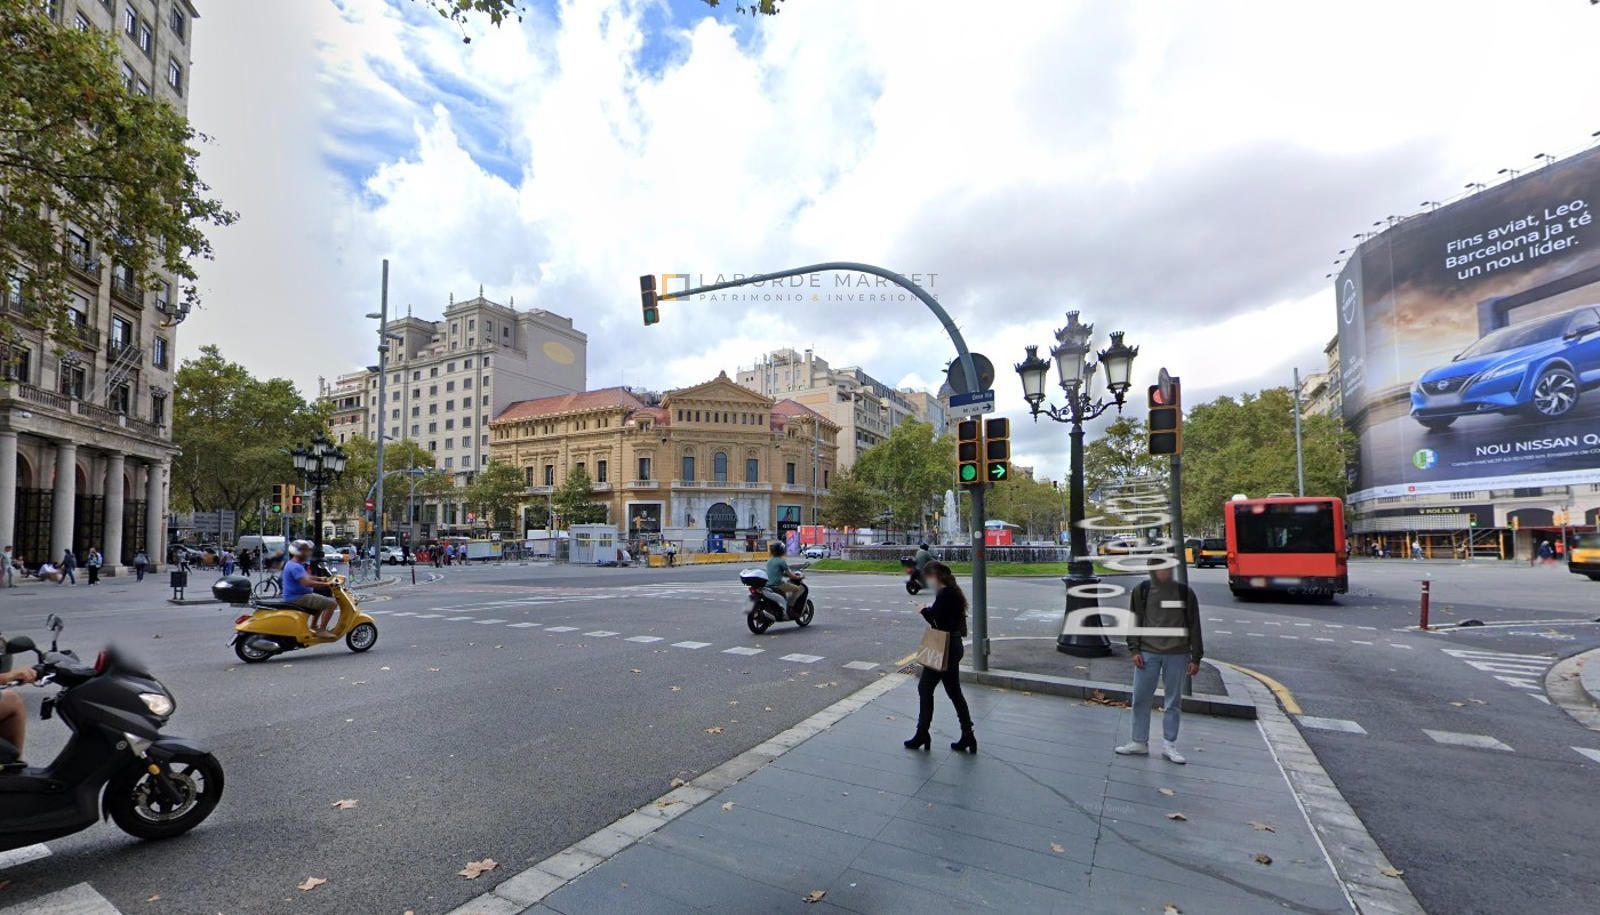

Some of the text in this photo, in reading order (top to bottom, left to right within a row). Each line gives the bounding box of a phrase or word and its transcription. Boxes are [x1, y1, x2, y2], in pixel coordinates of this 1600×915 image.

[1445, 210, 1592, 269] Barcelona ja té
[1447, 199, 1588, 253] Fins aviat, Leo.
[1457, 235, 1579, 280] un nou líder.
[1476, 433, 1600, 456] NOU NISSAN Q
